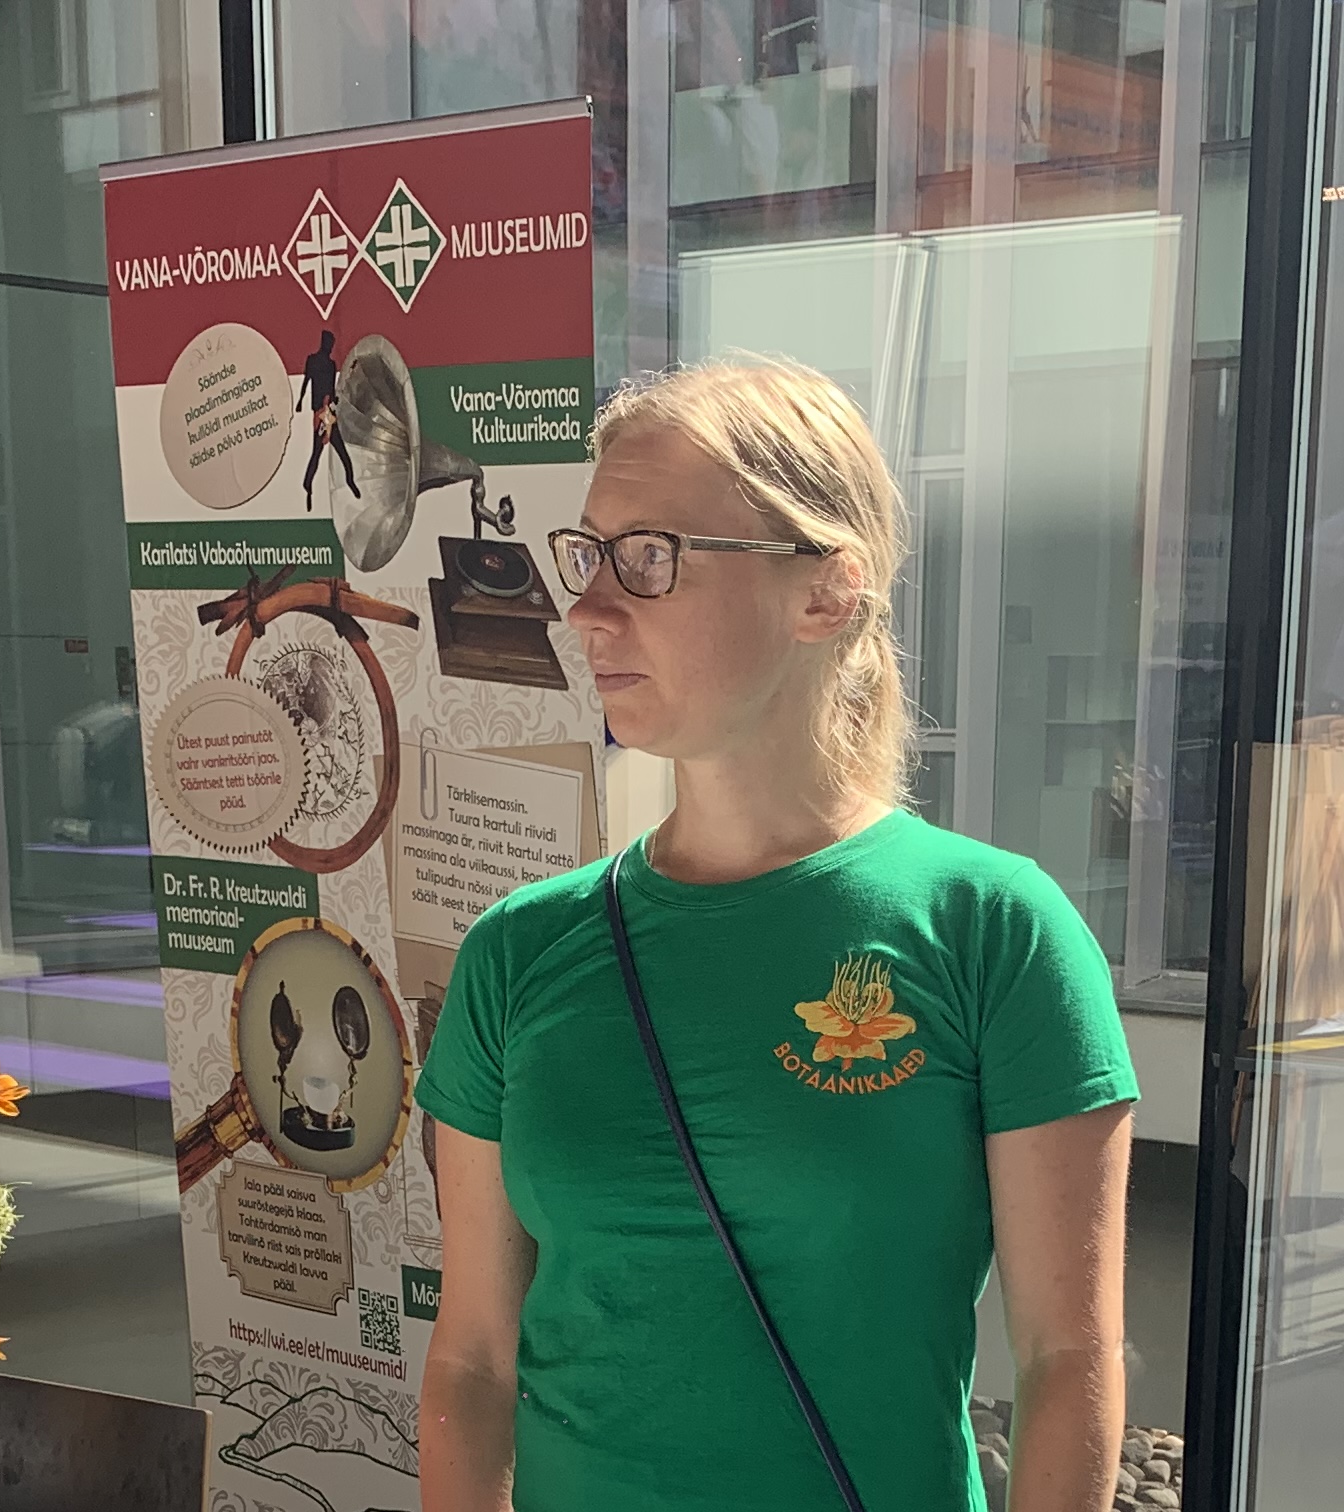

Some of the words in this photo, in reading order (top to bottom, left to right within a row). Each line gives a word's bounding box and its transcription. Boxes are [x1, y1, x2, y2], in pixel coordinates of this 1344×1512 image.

[115, 244, 283, 292] VANA-VÕROMAA
[450, 212, 588, 259] MUUSEUMID
[222, 394, 269, 427] muusikat
[450, 383, 580, 413] Vana-Võromaa
[471, 414, 581, 445] Kultuurikoda
[140, 540, 197, 567] Karilatsi
[199, 540, 333, 567] Vabaõhumuuseum
[205, 734, 230, 750] puust
[447, 785, 528, 814] Tärklisemassin.
[448, 808, 480, 827] Tuura
[483, 815, 522, 836] kartuli
[525, 825, 557, 843] riividi
[402, 823, 458, 846] massinaga
[461, 834, 475, 850] är,
[478, 838, 504, 855] riivit
[507, 843, 542, 863] kartul
[545, 852, 574, 869] sattõ
[404, 845, 447, 864] massina
[450, 853, 466, 868] ala
[163, 873, 186, 897] Dr.
[189, 875, 207, 899] Fr.
[210, 877, 223, 900] R.
[226, 879, 307, 908] Kreutzwaldi
[416, 868, 465, 890] tulipudru
[412, 888, 438, 903] säält
[441, 897, 464, 912] seest
[166, 905, 244, 929] memoriaal-
[168, 932, 235, 955] muuseum
[772, 1041, 926, 1095] BOTAANIKAAED
[304, 1230, 327, 1243] man
[243, 1250, 297, 1275] Kreutzwaldi
[229, 1318, 407, 1382] https://wi.ee/et/muuseumid/
